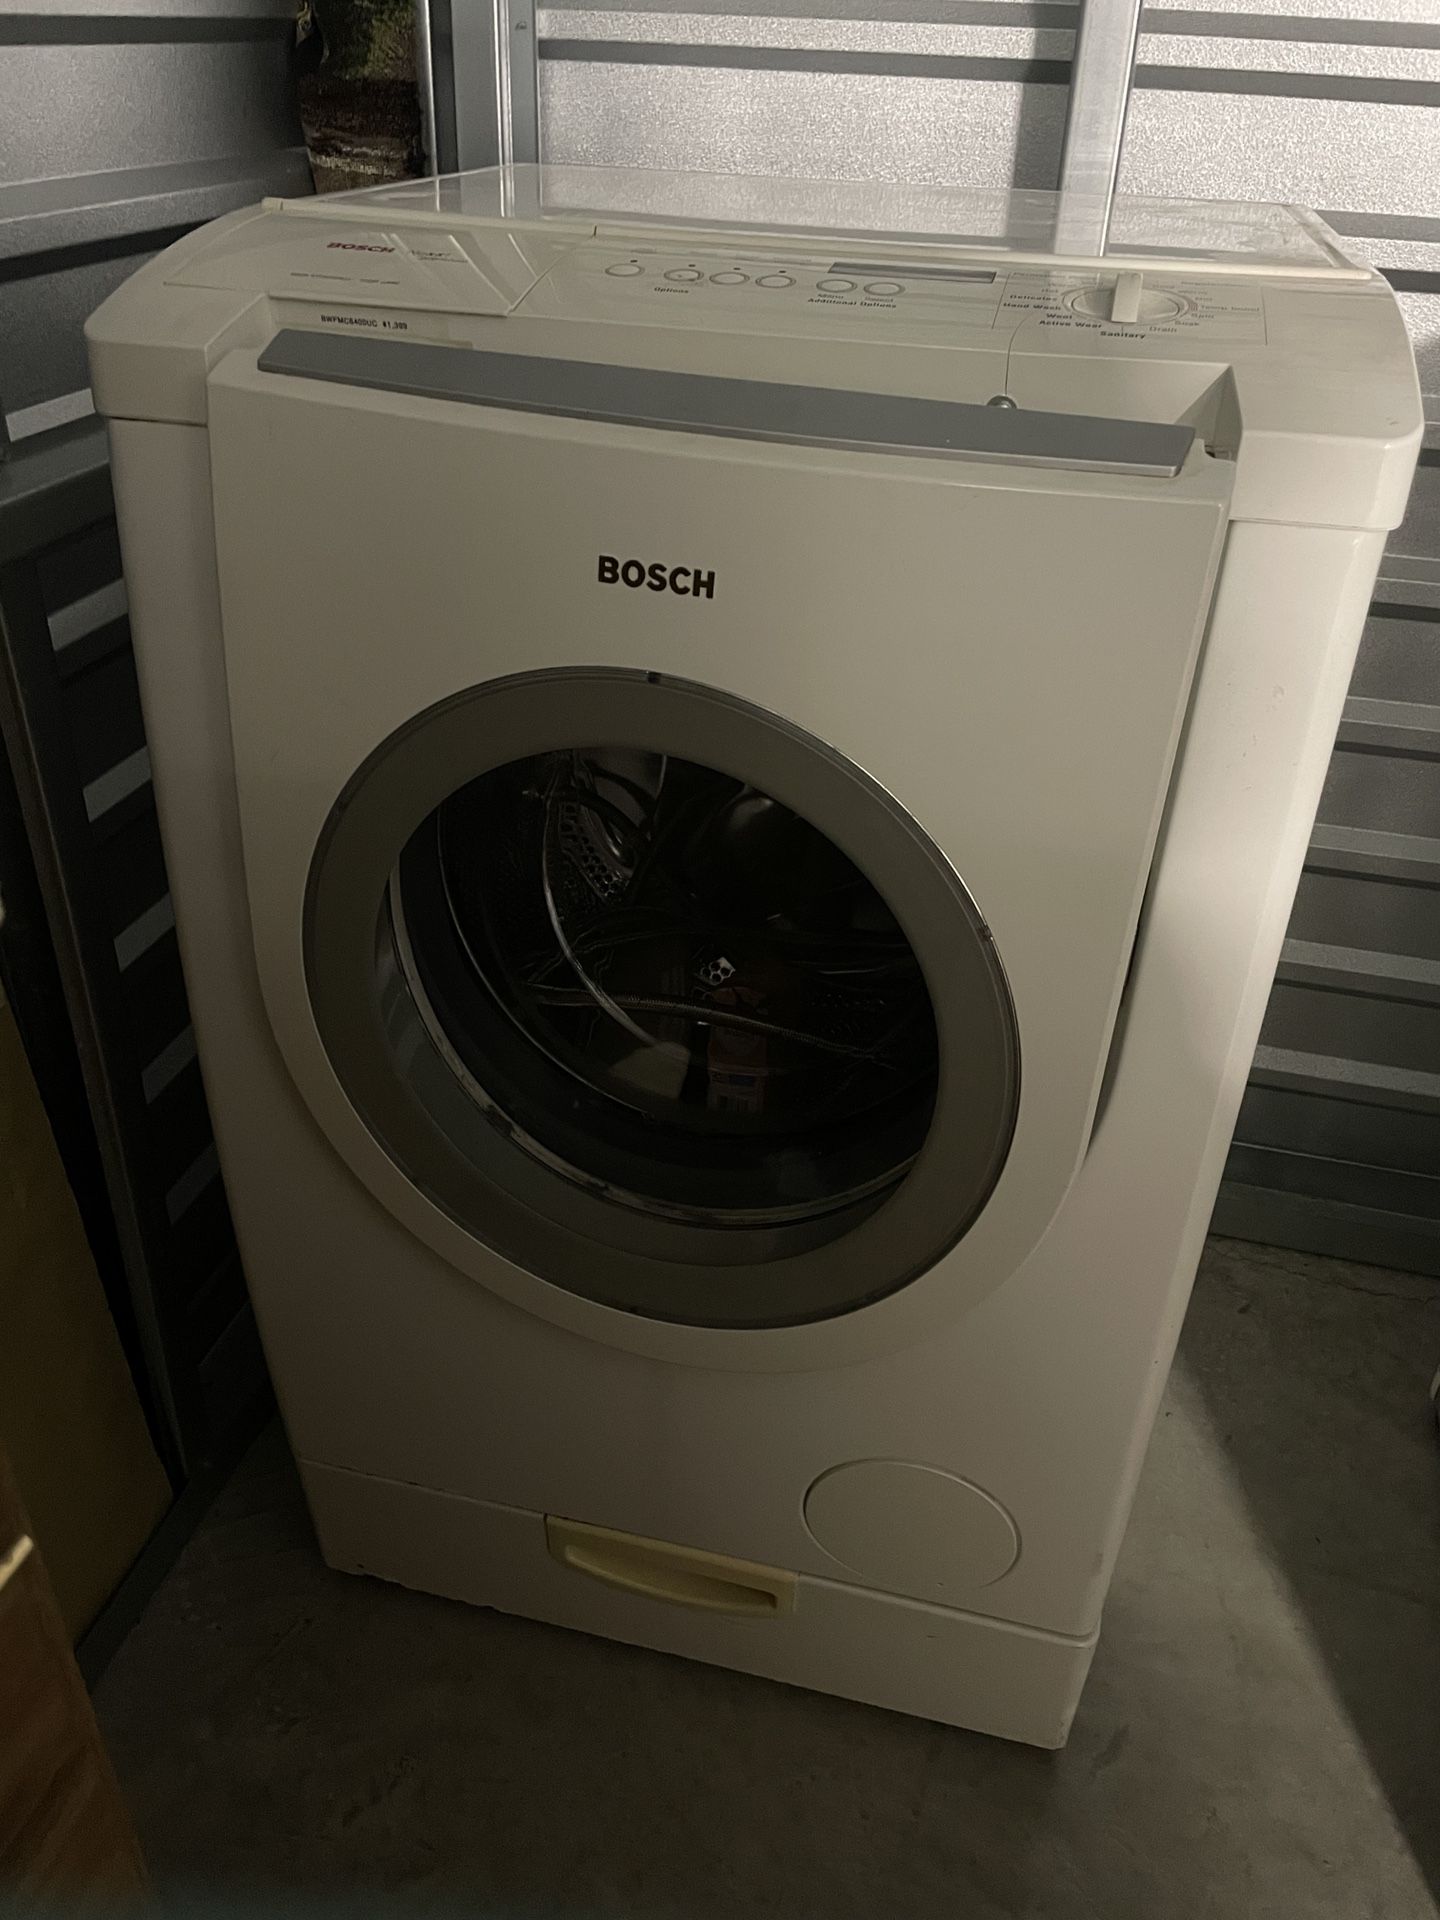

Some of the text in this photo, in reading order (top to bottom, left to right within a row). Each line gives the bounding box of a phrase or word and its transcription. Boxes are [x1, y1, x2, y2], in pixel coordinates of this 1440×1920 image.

[327, 241, 397, 253] BOSCH
[654, 286, 689, 294] Options
[807, 297, 857, 306] Additional
[1039, 319, 1103, 329] Active Wear
[1099, 330, 1147, 339] Sanitary
[597, 554, 716, 599] BOSCH
